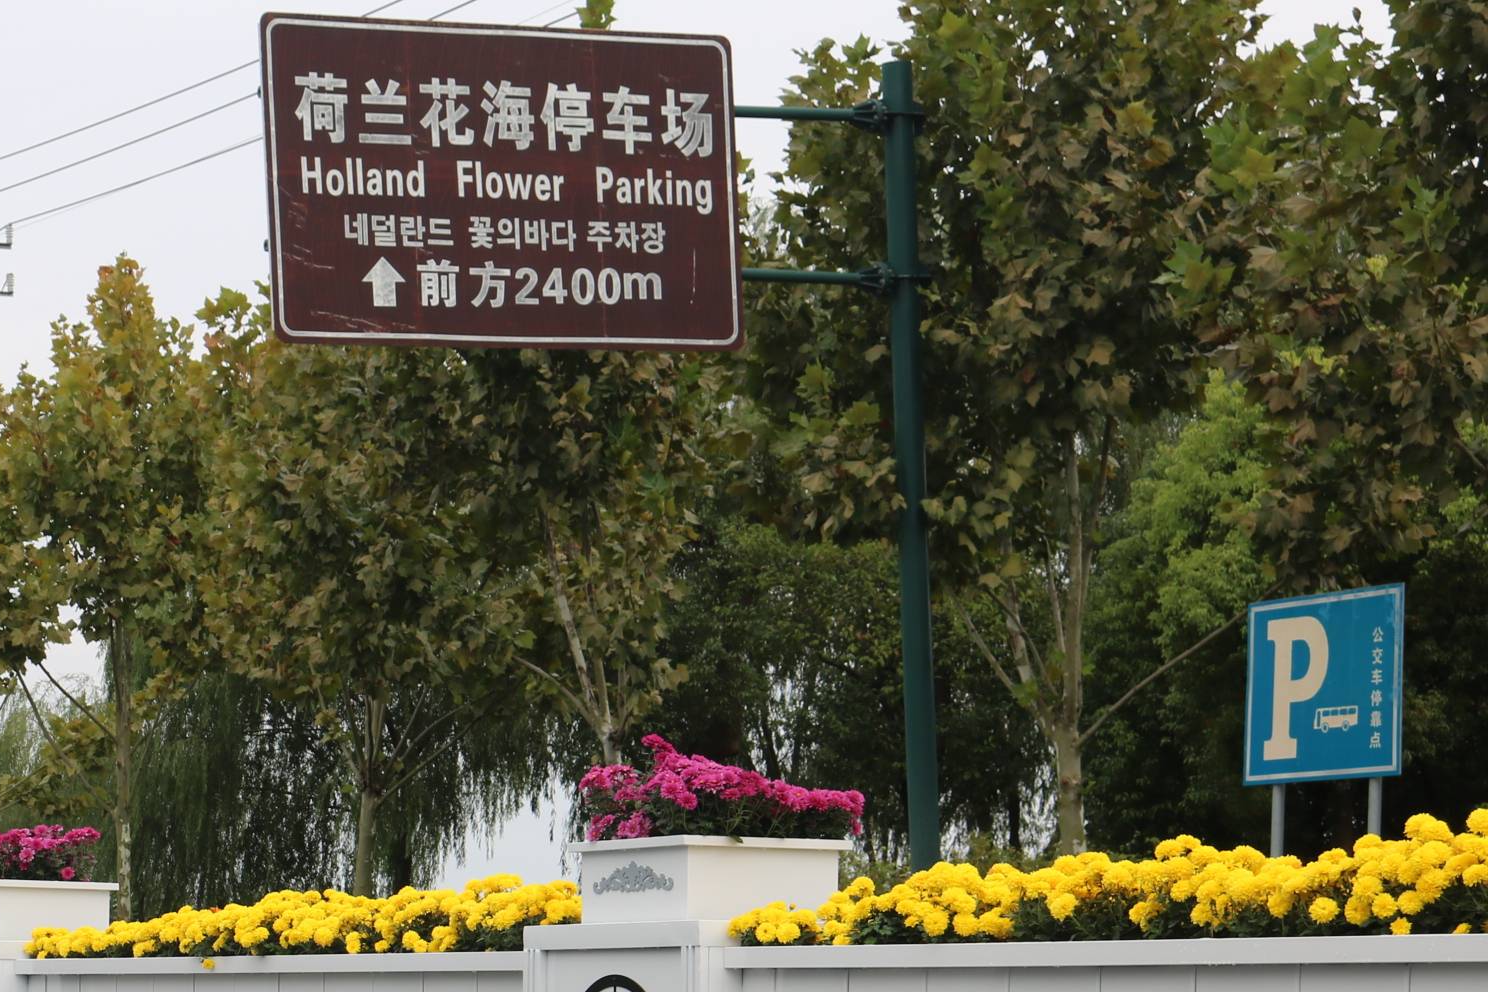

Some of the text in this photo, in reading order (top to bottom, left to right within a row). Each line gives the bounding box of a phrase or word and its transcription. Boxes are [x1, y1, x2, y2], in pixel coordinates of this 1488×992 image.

[294, 71, 714, 158] 荷兰花海停车场
[300, 156, 713, 215] Holland Flower Parking
[343, 213, 666, 255] 네덜란드 꽃의바다 주차장
[1263, 615, 1329, 761] P
[1369, 626, 1385, 749] 公交车停靠点
